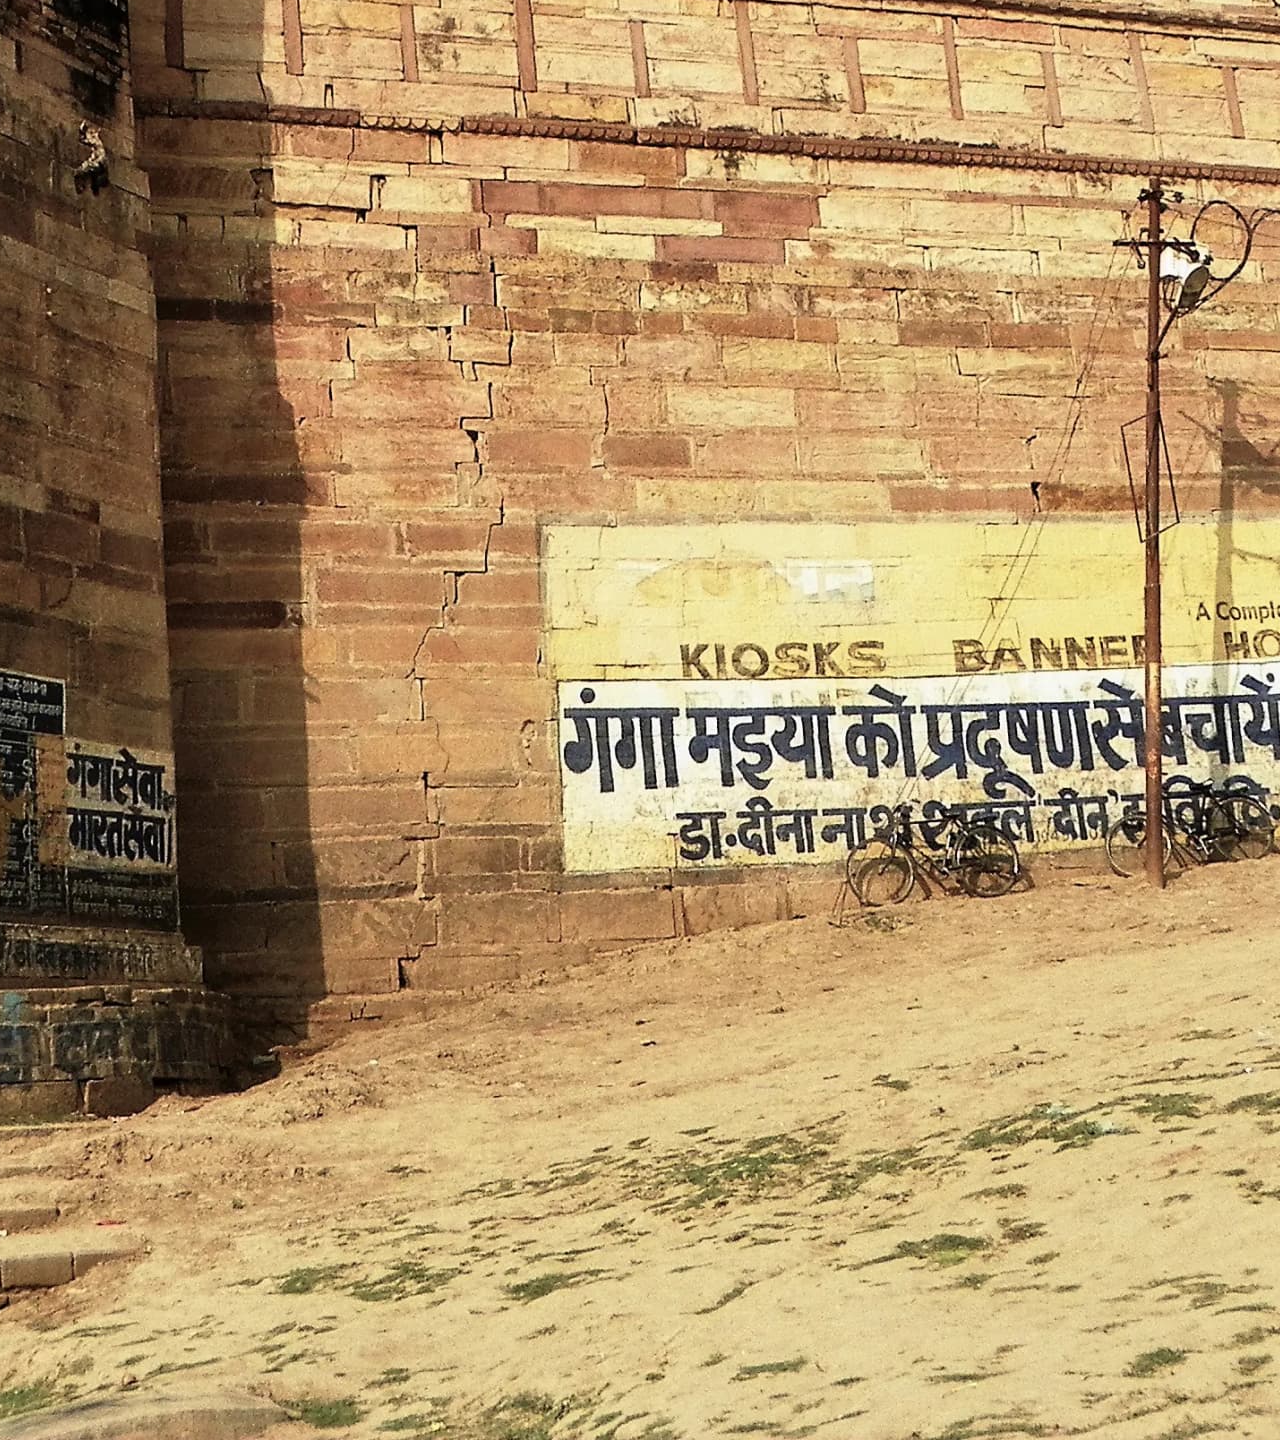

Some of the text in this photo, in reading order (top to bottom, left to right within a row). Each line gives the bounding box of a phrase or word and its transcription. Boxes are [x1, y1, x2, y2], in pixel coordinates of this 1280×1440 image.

[1196, 601, 1211, 621] A
[679, 640, 886, 679] KIOSKS
[563, 688, 680, 793] गंगा
[685, 705, 836, 790] मइया
[841, 683, 917, 780] को
[919, 700, 1094, 801] प्रदूषण
